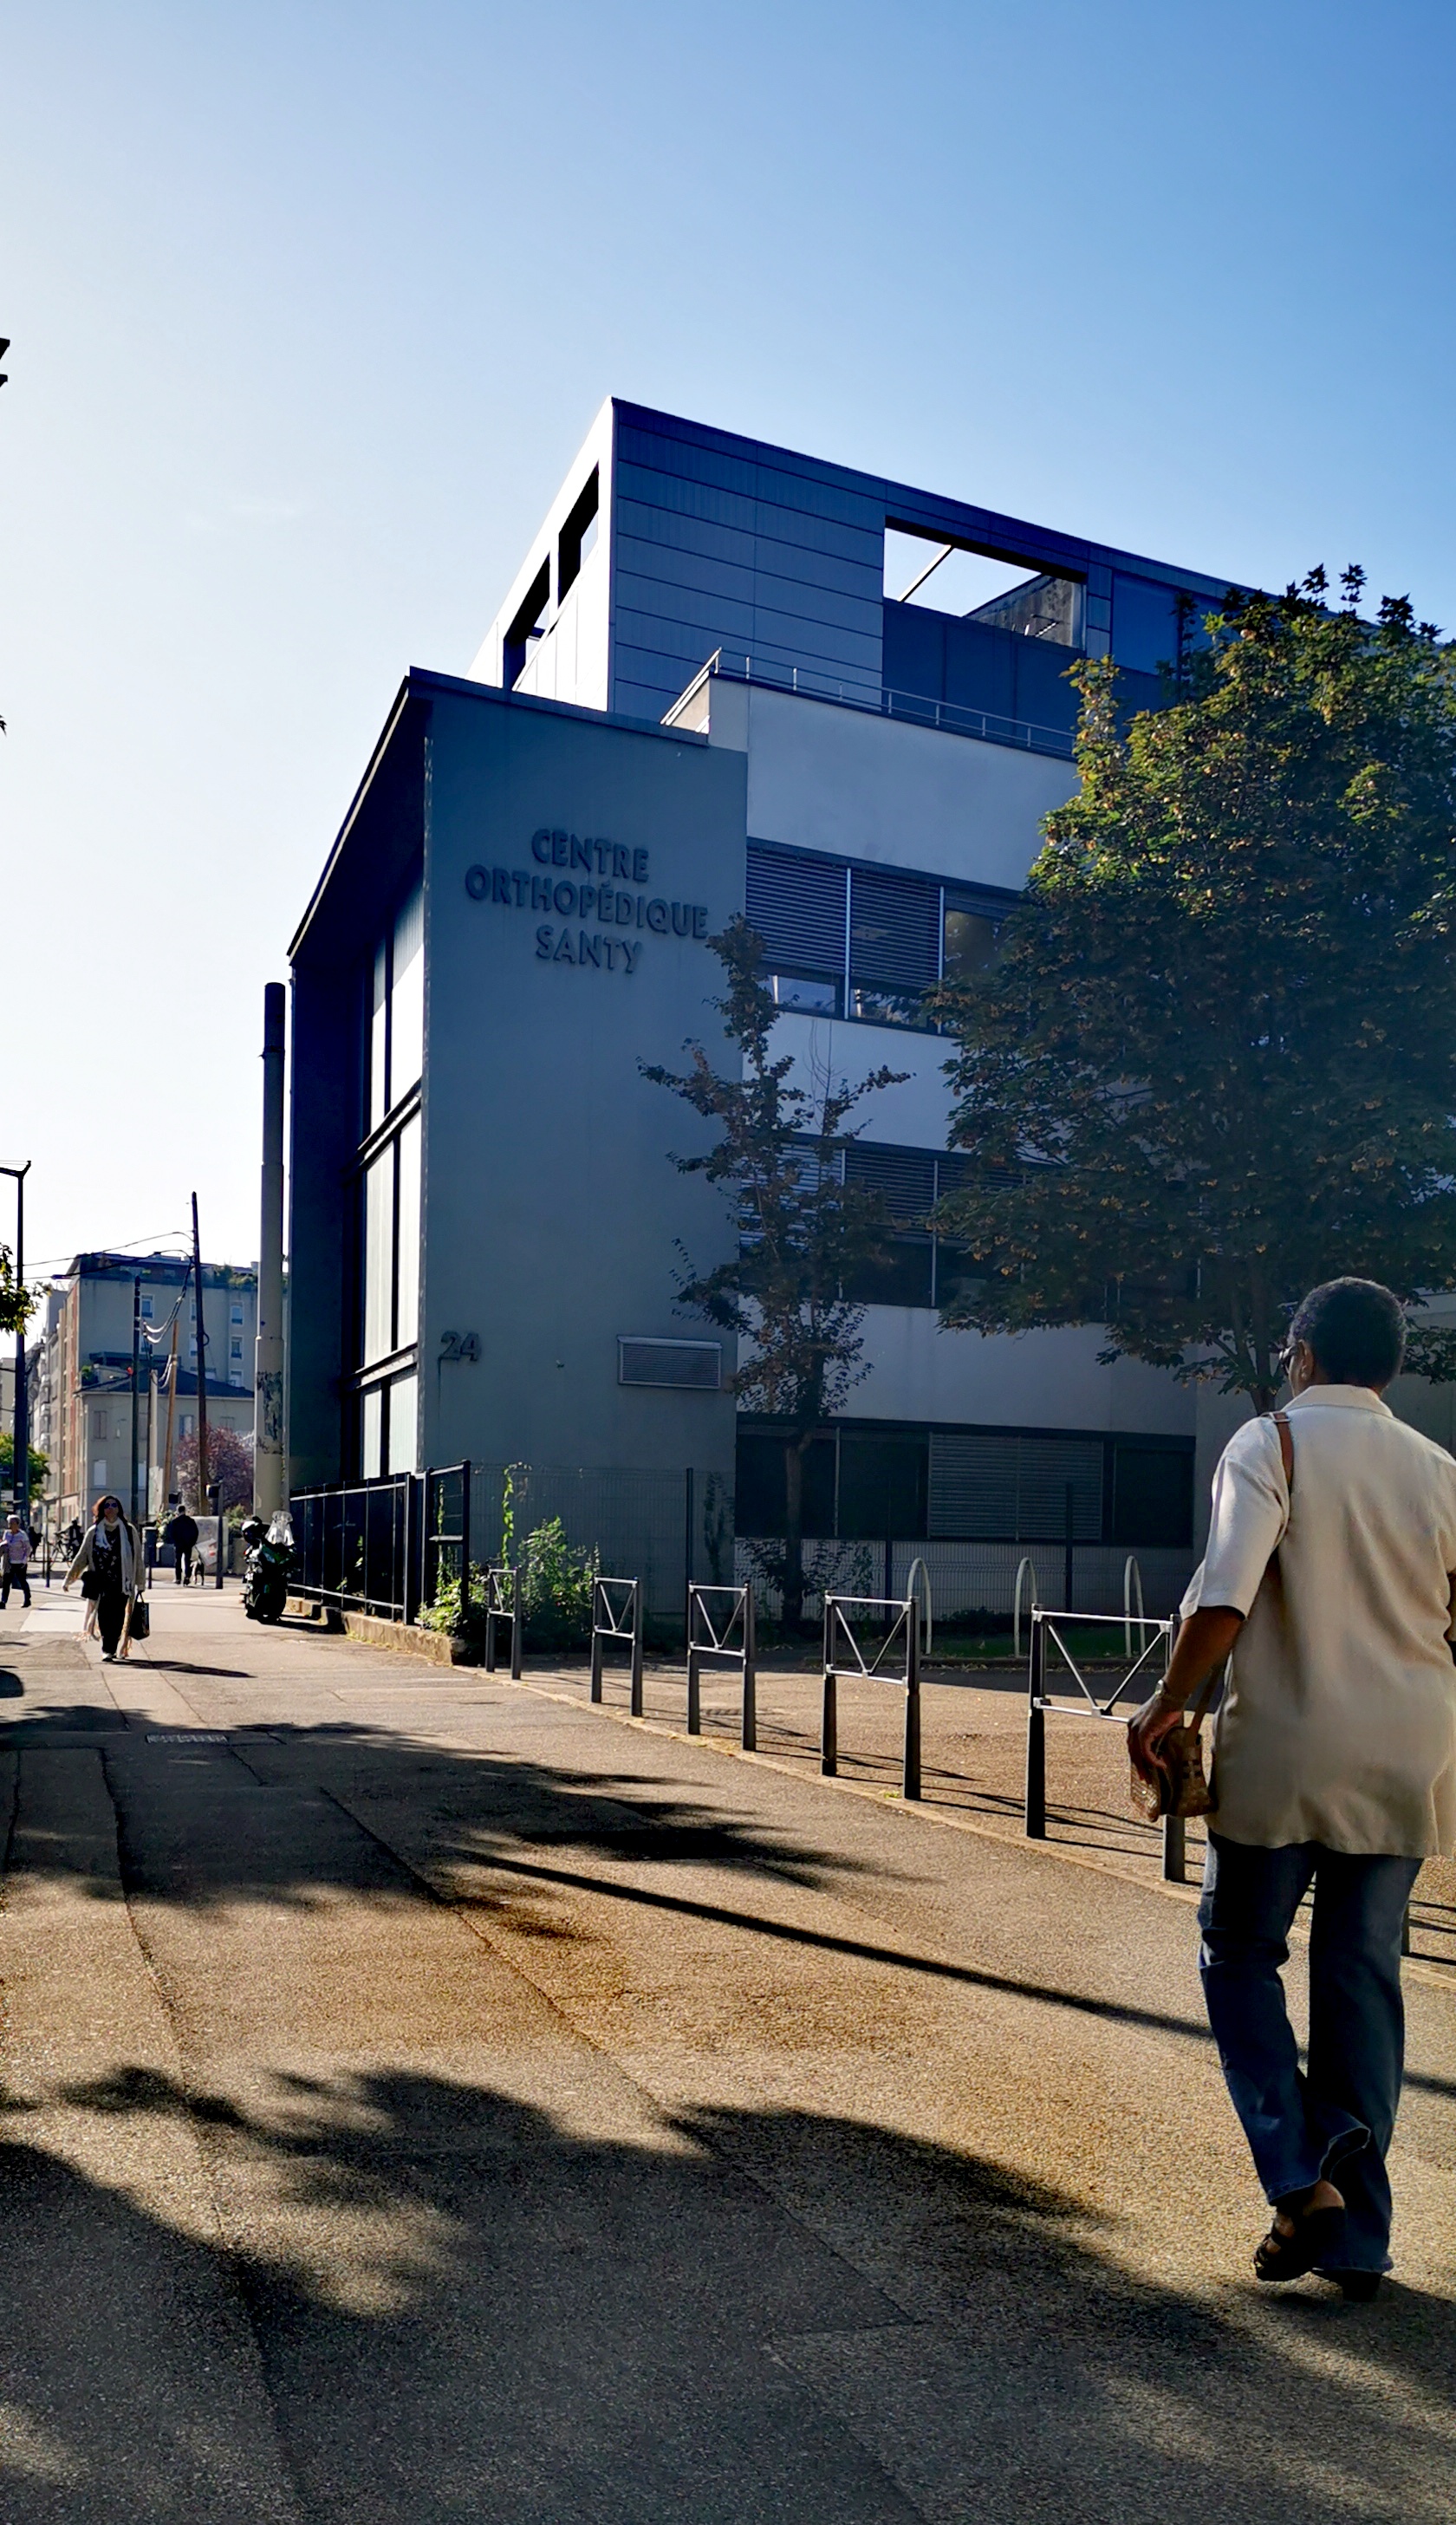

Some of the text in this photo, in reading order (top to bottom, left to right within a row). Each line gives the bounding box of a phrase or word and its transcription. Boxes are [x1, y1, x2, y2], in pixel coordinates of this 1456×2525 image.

[531, 828, 649, 883] CENTRE
[465, 864, 710, 939] ORTHOPÉDIQUE
[535, 924, 643, 973] SANTY
[439, 1331, 481, 1361] 24
